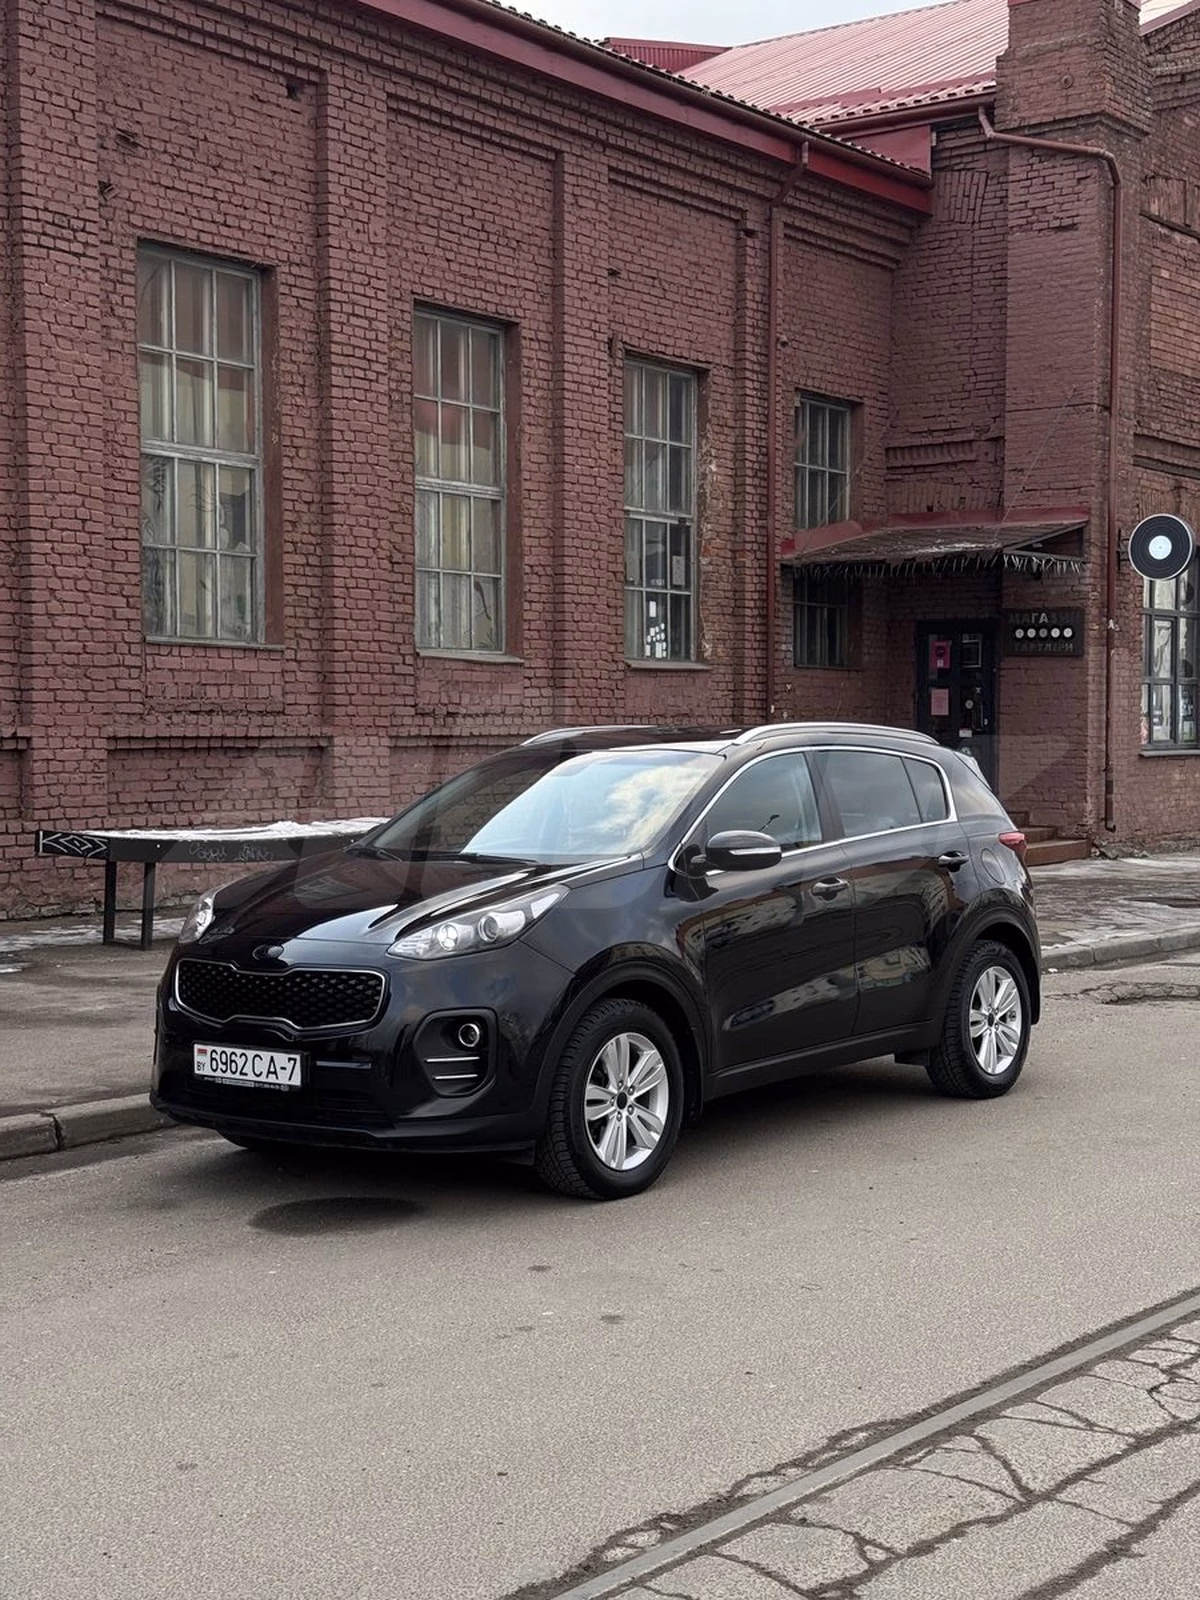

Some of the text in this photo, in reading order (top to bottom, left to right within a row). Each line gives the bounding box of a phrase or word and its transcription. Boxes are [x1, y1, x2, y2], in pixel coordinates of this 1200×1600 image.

[196, 1061, 206, 1071] BY
[209, 1049, 298, 1081] 6962 CA-7
